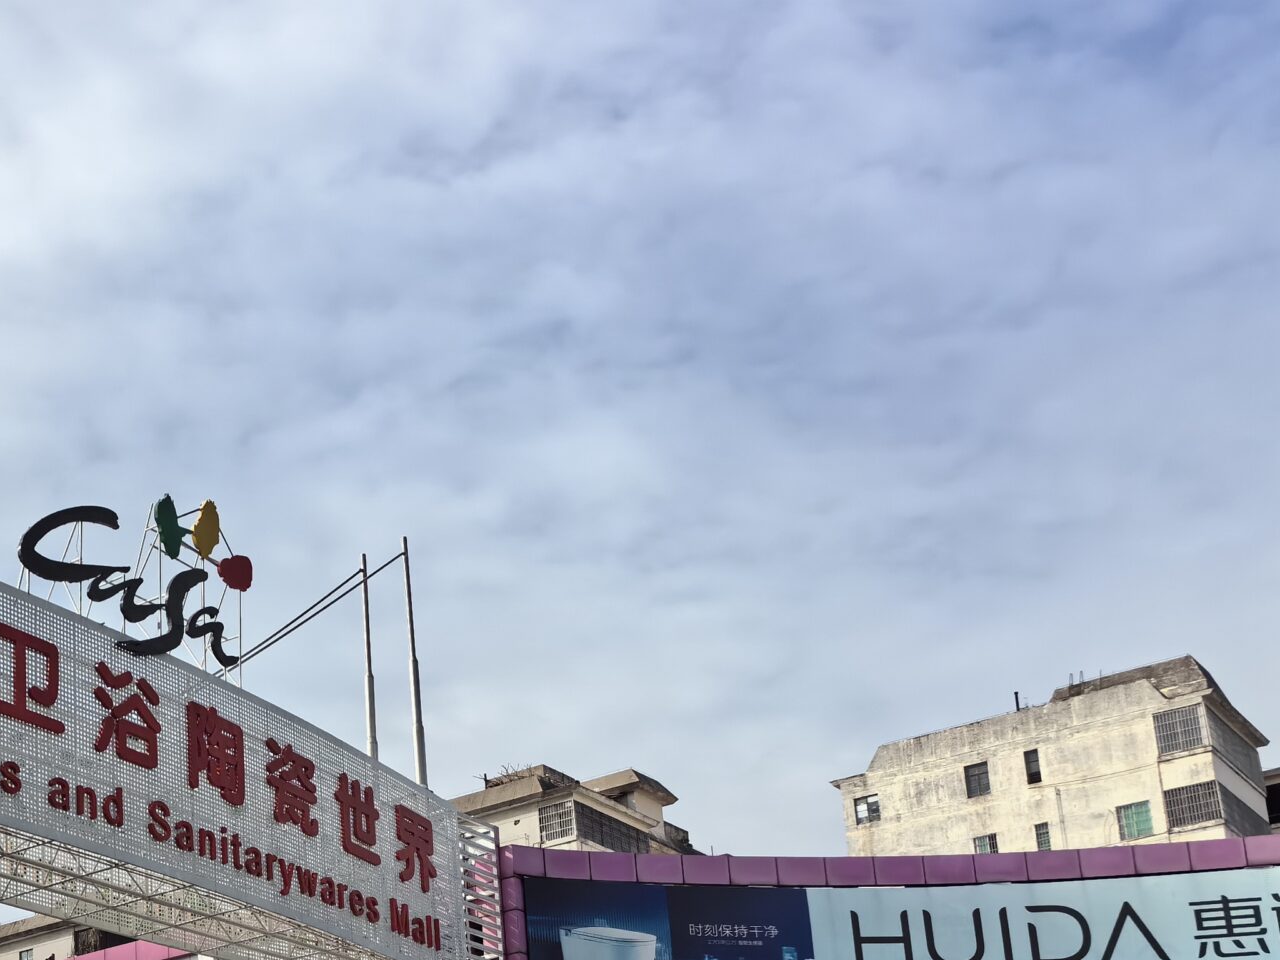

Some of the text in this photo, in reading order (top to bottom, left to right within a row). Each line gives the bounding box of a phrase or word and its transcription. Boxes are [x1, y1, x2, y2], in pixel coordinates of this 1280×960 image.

[48, 773, 124, 828] and
[148, 801, 379, 923] Sanitarywares
[390, 898, 442, 951] Mall
[689, 923, 779, 938] 时刻保持干净
[1188, 893, 1280, 959] 惠
